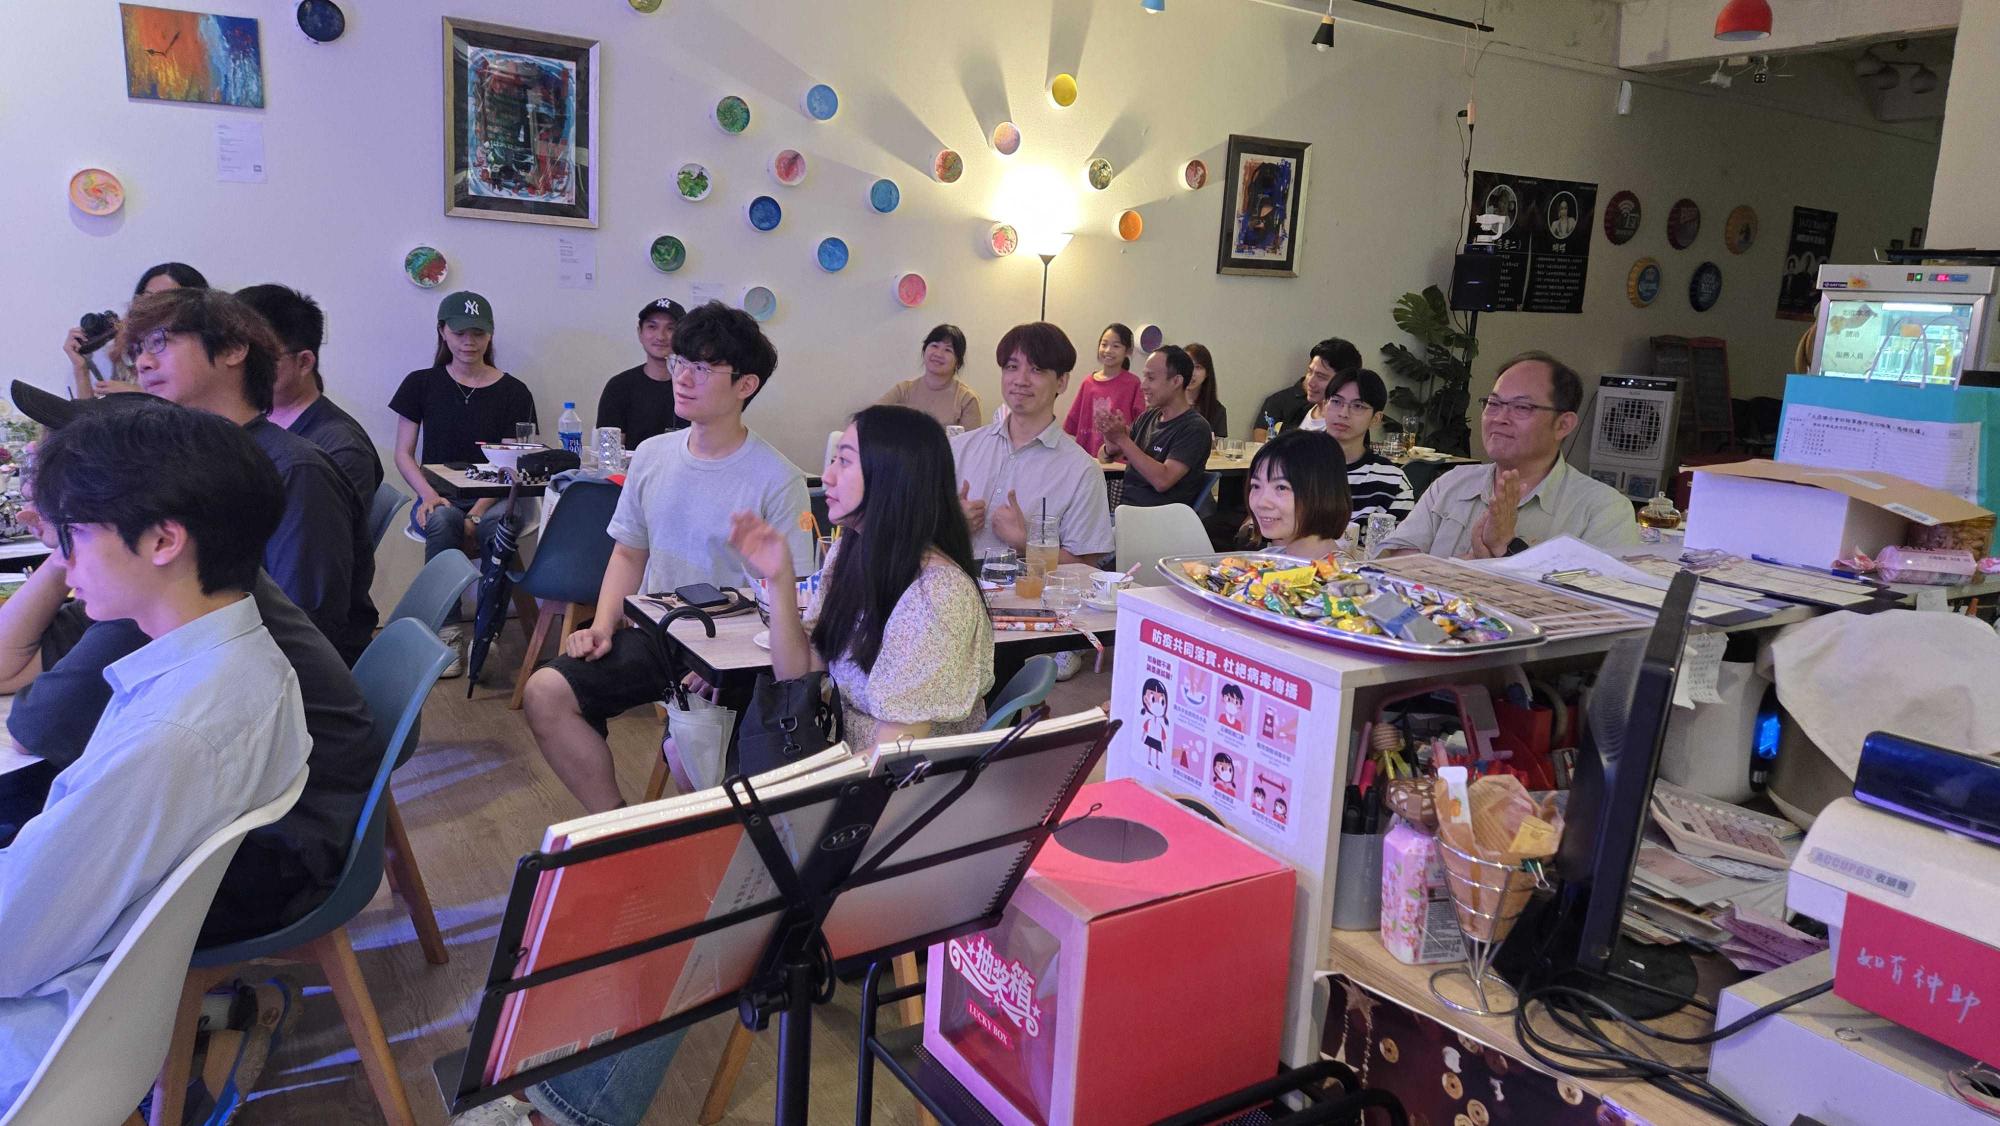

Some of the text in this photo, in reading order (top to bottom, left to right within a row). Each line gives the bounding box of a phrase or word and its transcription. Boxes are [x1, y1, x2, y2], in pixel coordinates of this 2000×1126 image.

[464, 299, 480, 316] NY
[656, 297, 671, 309] NY
[1834, 351, 1864, 360] 服務人員
[1815, 852, 1873, 879] ACCUPOS
[1857, 946, 1981, 1024] 如有神助
[969, 1003, 1008, 1046] LUCKY BOX
